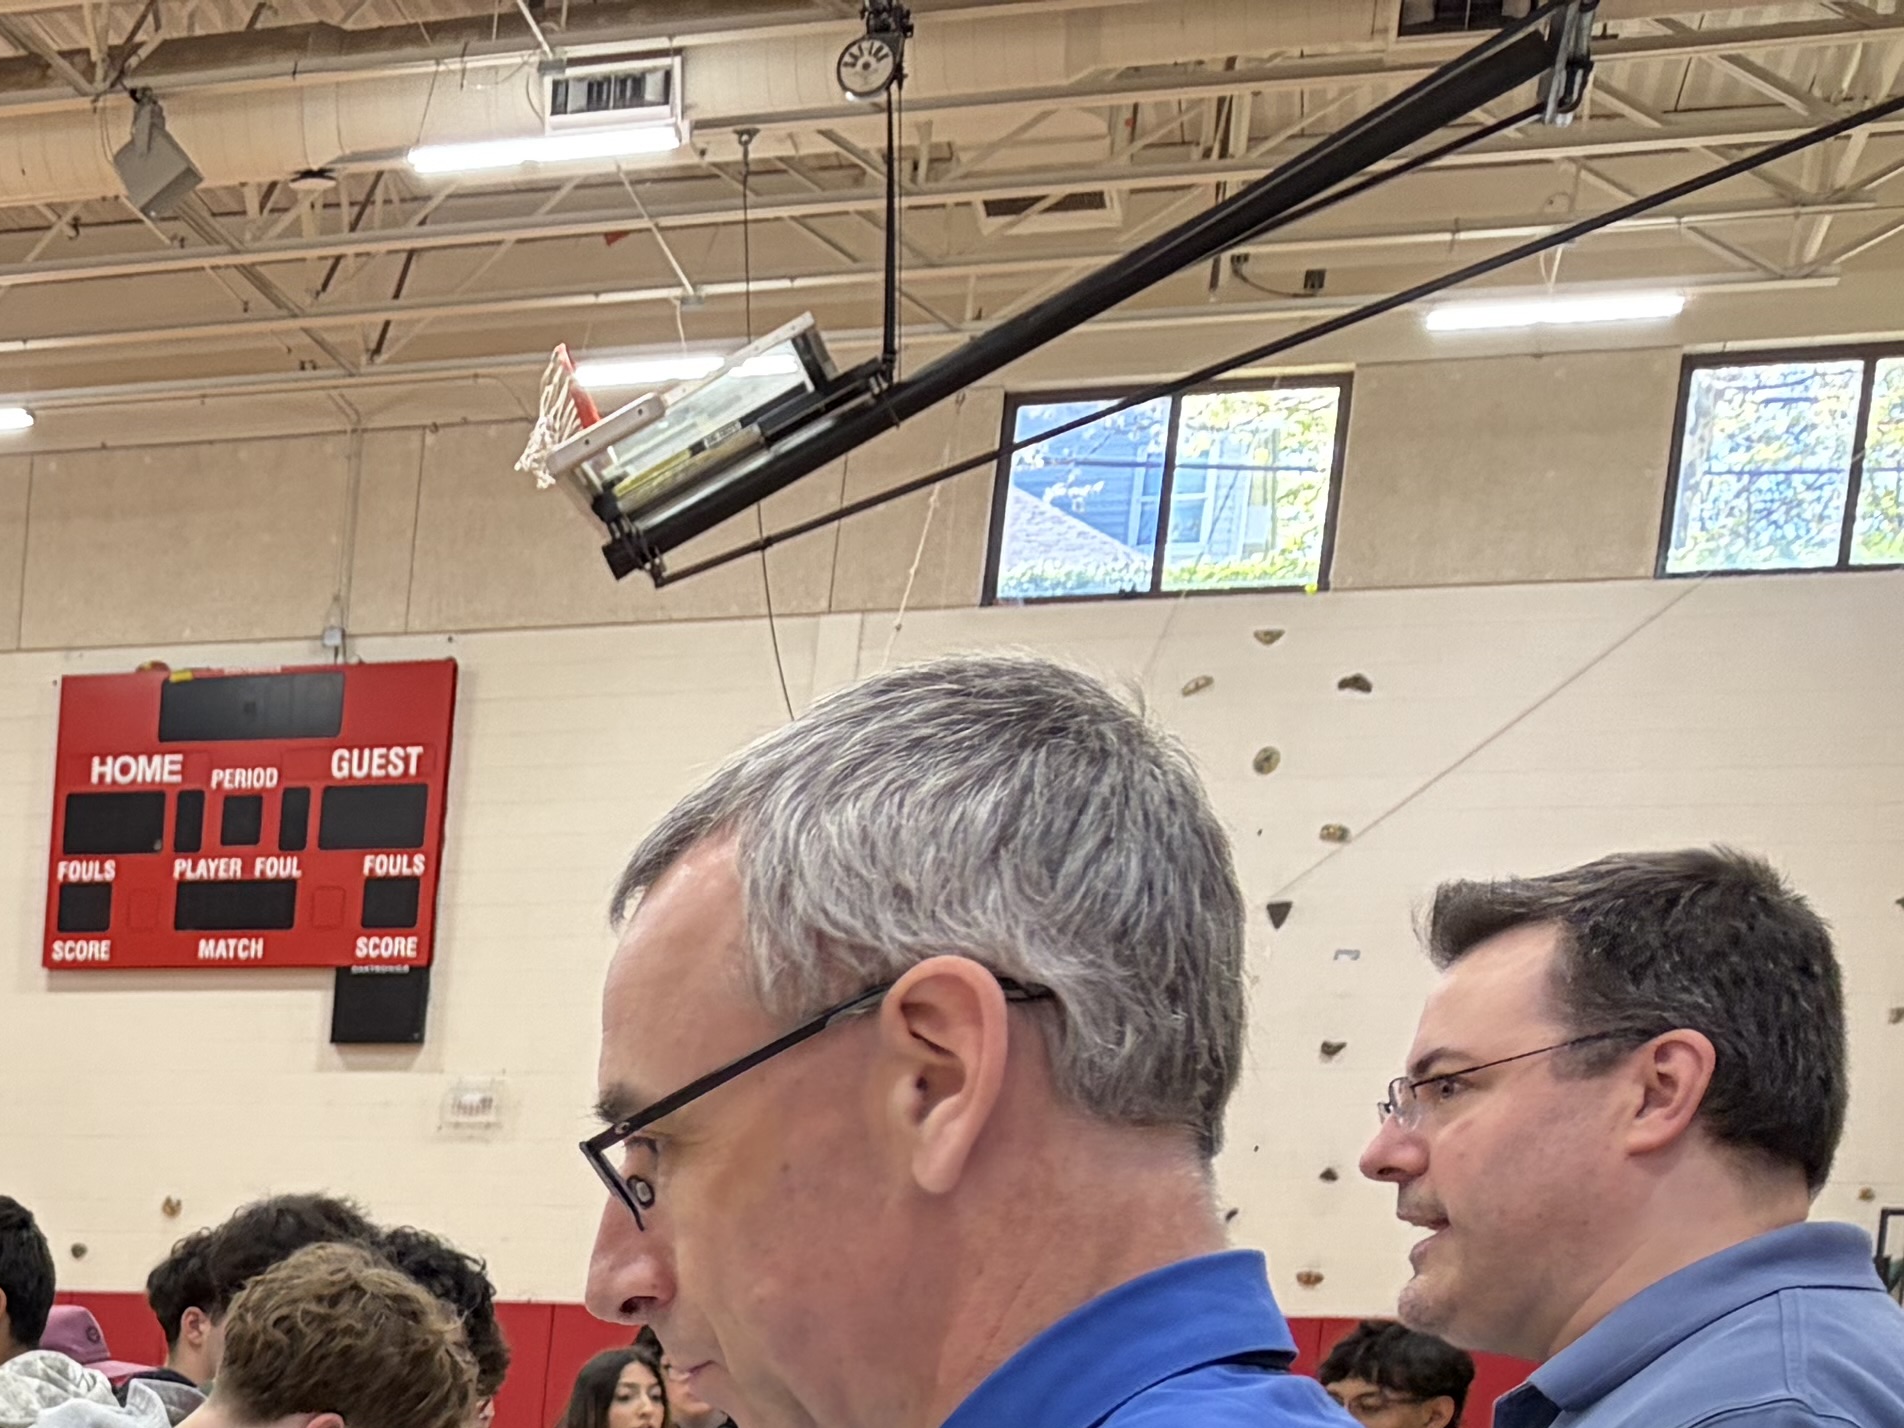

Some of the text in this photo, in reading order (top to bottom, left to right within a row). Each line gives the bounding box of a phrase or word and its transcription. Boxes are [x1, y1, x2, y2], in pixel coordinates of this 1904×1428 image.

[91, 755, 183, 784] HOME
[331, 746, 423, 778] GUEST
[211, 767, 278, 789] PERIOD
[58, 860, 115, 881] FOULS
[173, 857, 302, 879] PLAYER FOUL
[363, 855, 425, 876] FOULS
[52, 940, 111, 960] SCORE
[198, 938, 263, 959] MATCH
[355, 936, 417, 958] SCORE
